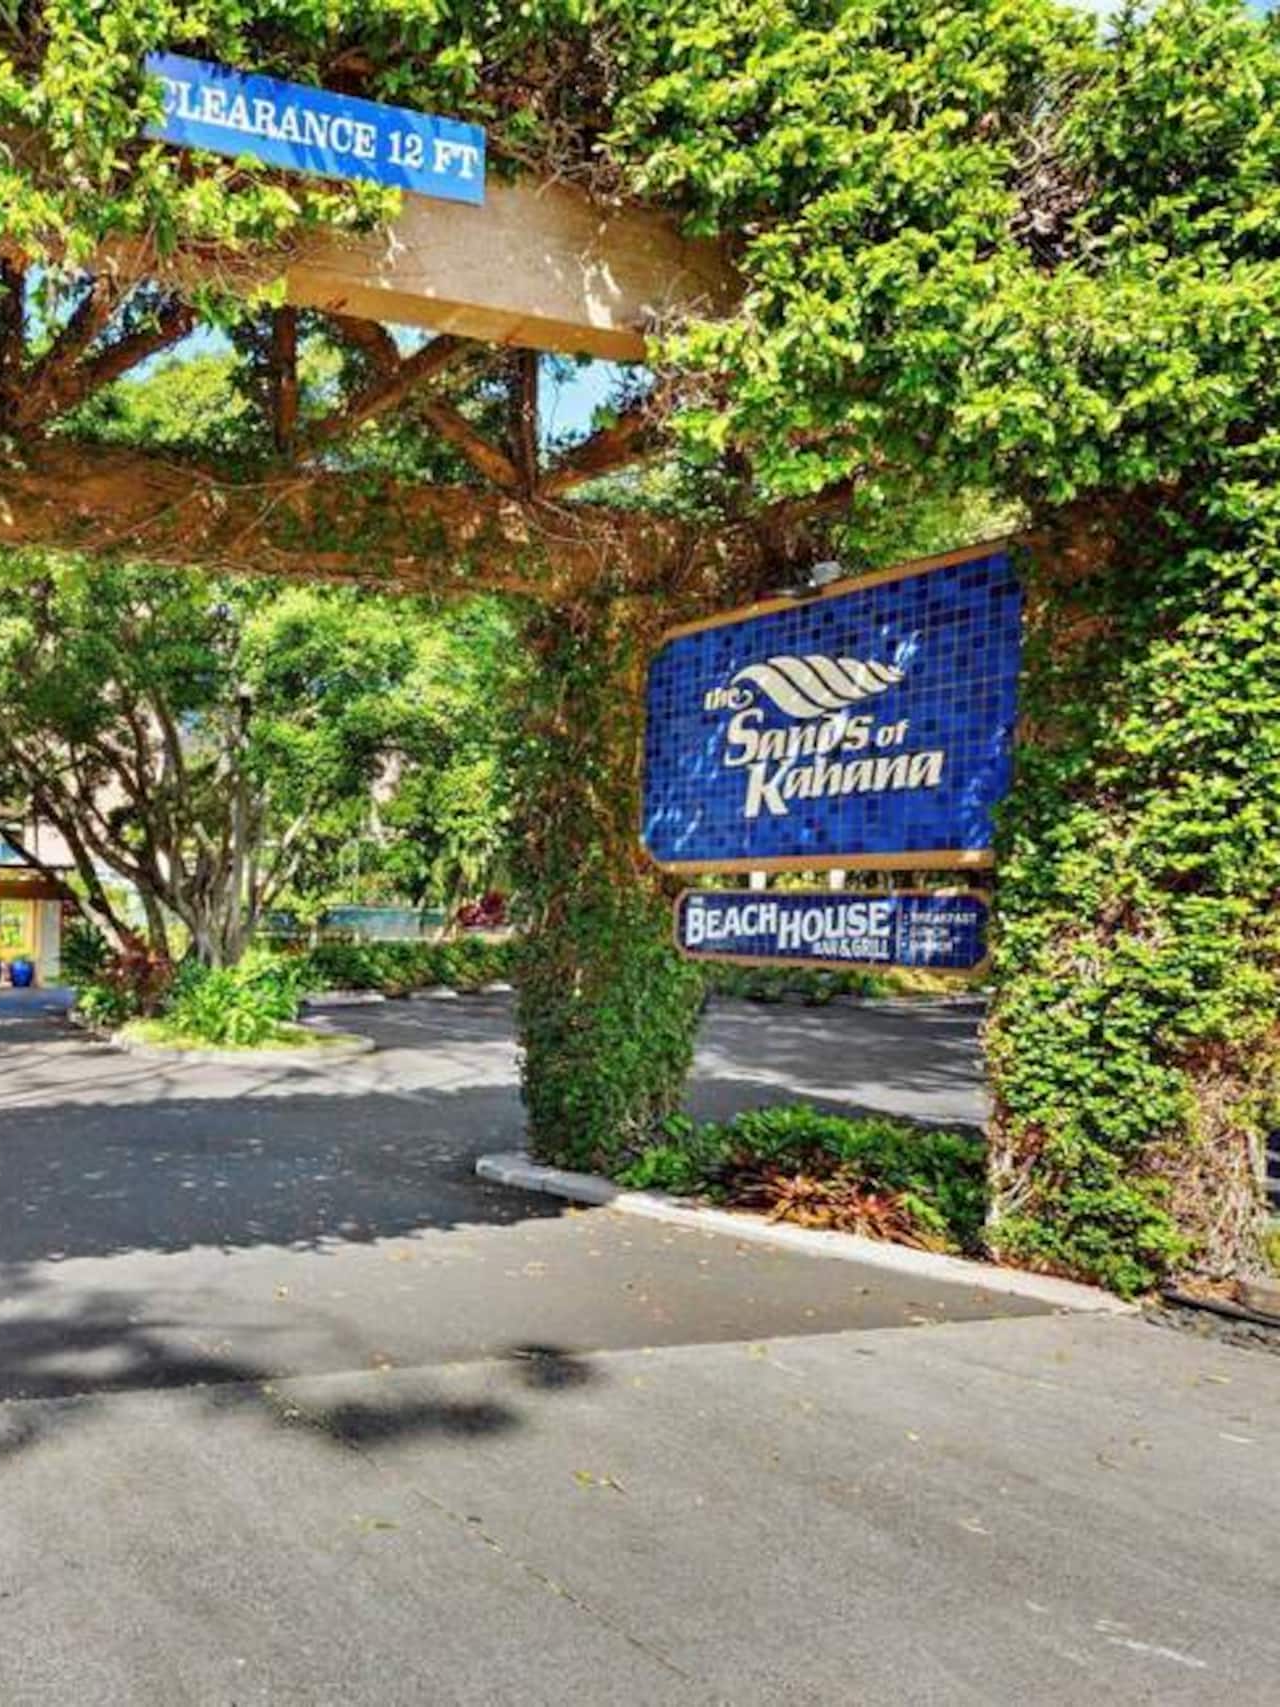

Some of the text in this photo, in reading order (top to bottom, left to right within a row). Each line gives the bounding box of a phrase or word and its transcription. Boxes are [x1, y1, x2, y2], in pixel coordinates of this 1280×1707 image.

[387, 129, 423, 169] 12
[432, 137, 479, 180] FT
[724, 708, 911, 767] Sands of
[744, 750, 945, 819] Kahana
[685, 902, 890, 950] BEACH HOUSE
